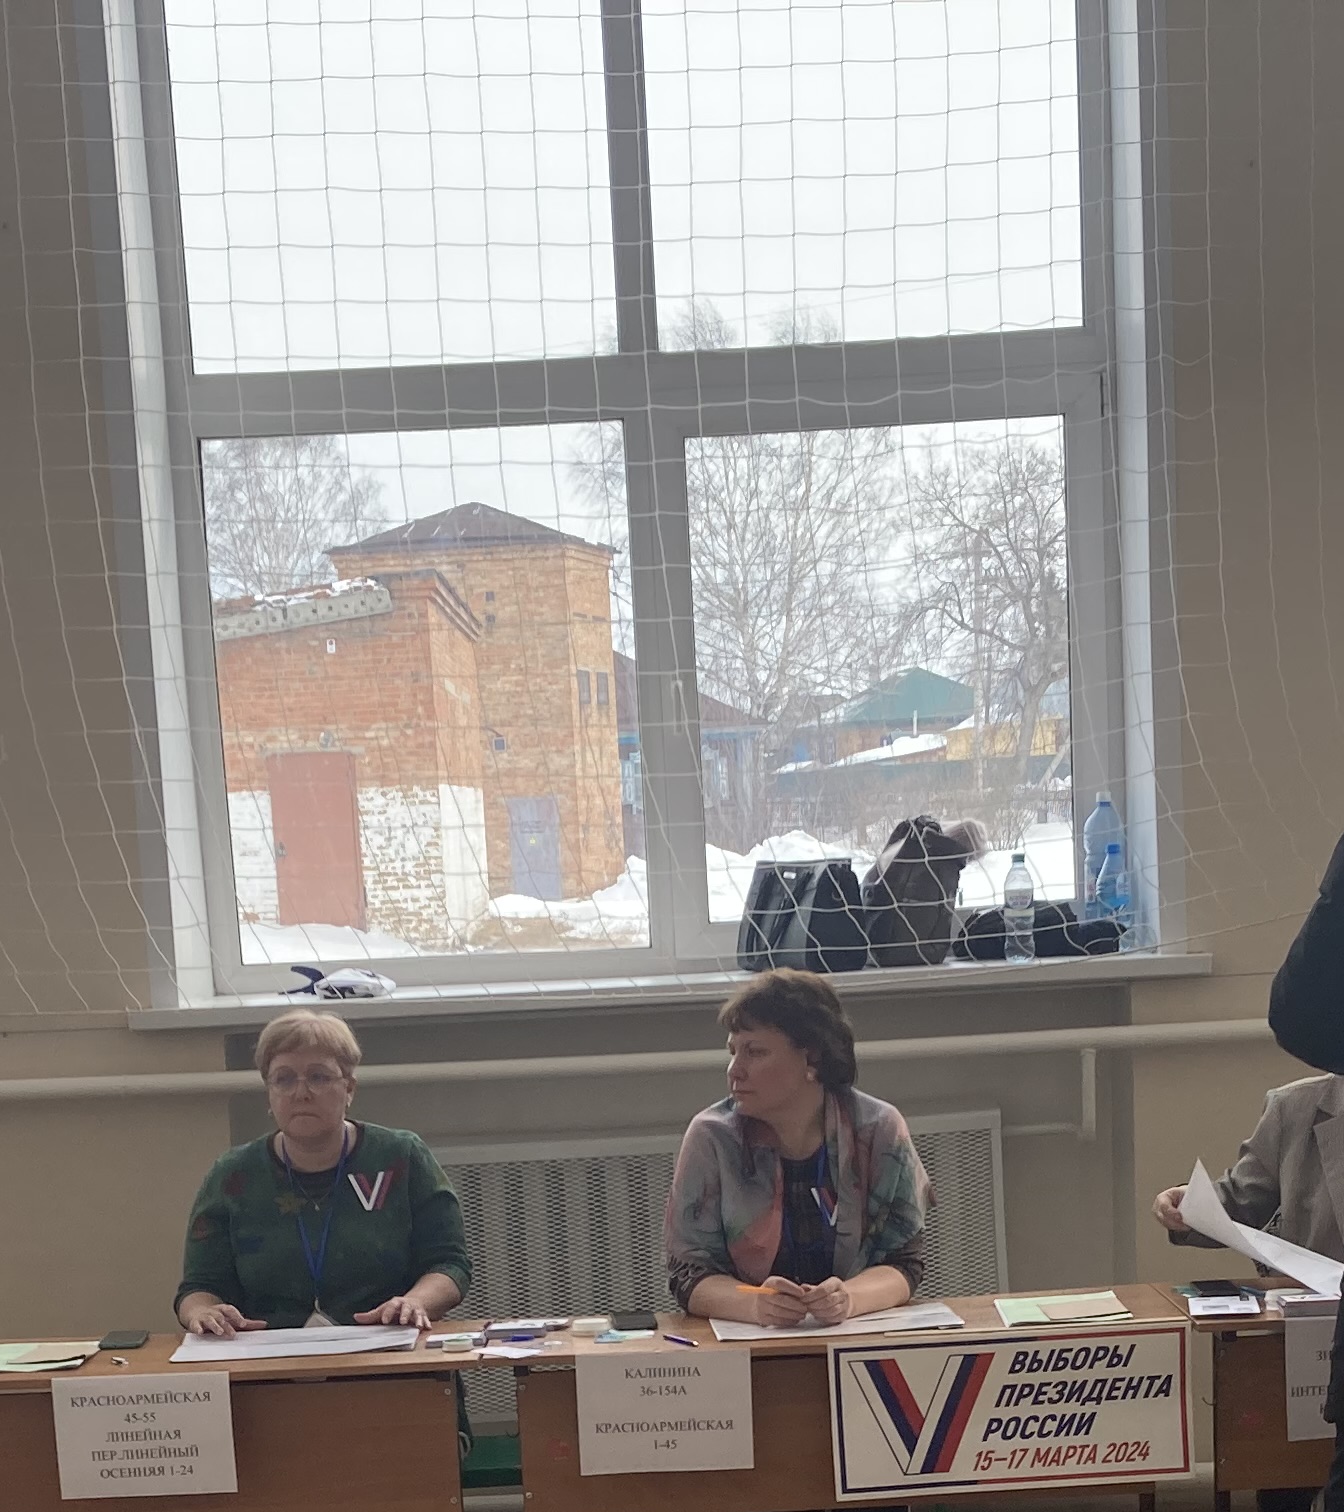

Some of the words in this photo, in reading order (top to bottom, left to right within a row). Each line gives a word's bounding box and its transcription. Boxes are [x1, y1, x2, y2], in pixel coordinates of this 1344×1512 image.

[1008, 1343, 1137, 1375] ВЫБОРЫ
[624, 1366, 702, 1379] КАЛИНИНА
[994, 1374, 1174, 1408] ПРЕЗИДЕНТА
[70, 1391, 212, 1408] КРАСНОАРМЕЙСКАЯ
[123, 1412, 157, 1424] 45-55
[595, 1418, 734, 1434] КРАСНОАРМЕЙСКАЯ
[981, 1411, 1097, 1442] РОССИИ
[105, 1428, 182, 1443] ЛИНЕЙНАЯ
[1029, 1444, 1099, 1469] МАРТА
[1101, 1440, 1151, 1465] 2024
[99, 1467, 166, 1479] ОСЕННЯЯ
[170, 1465, 194, 1476] 1-24
